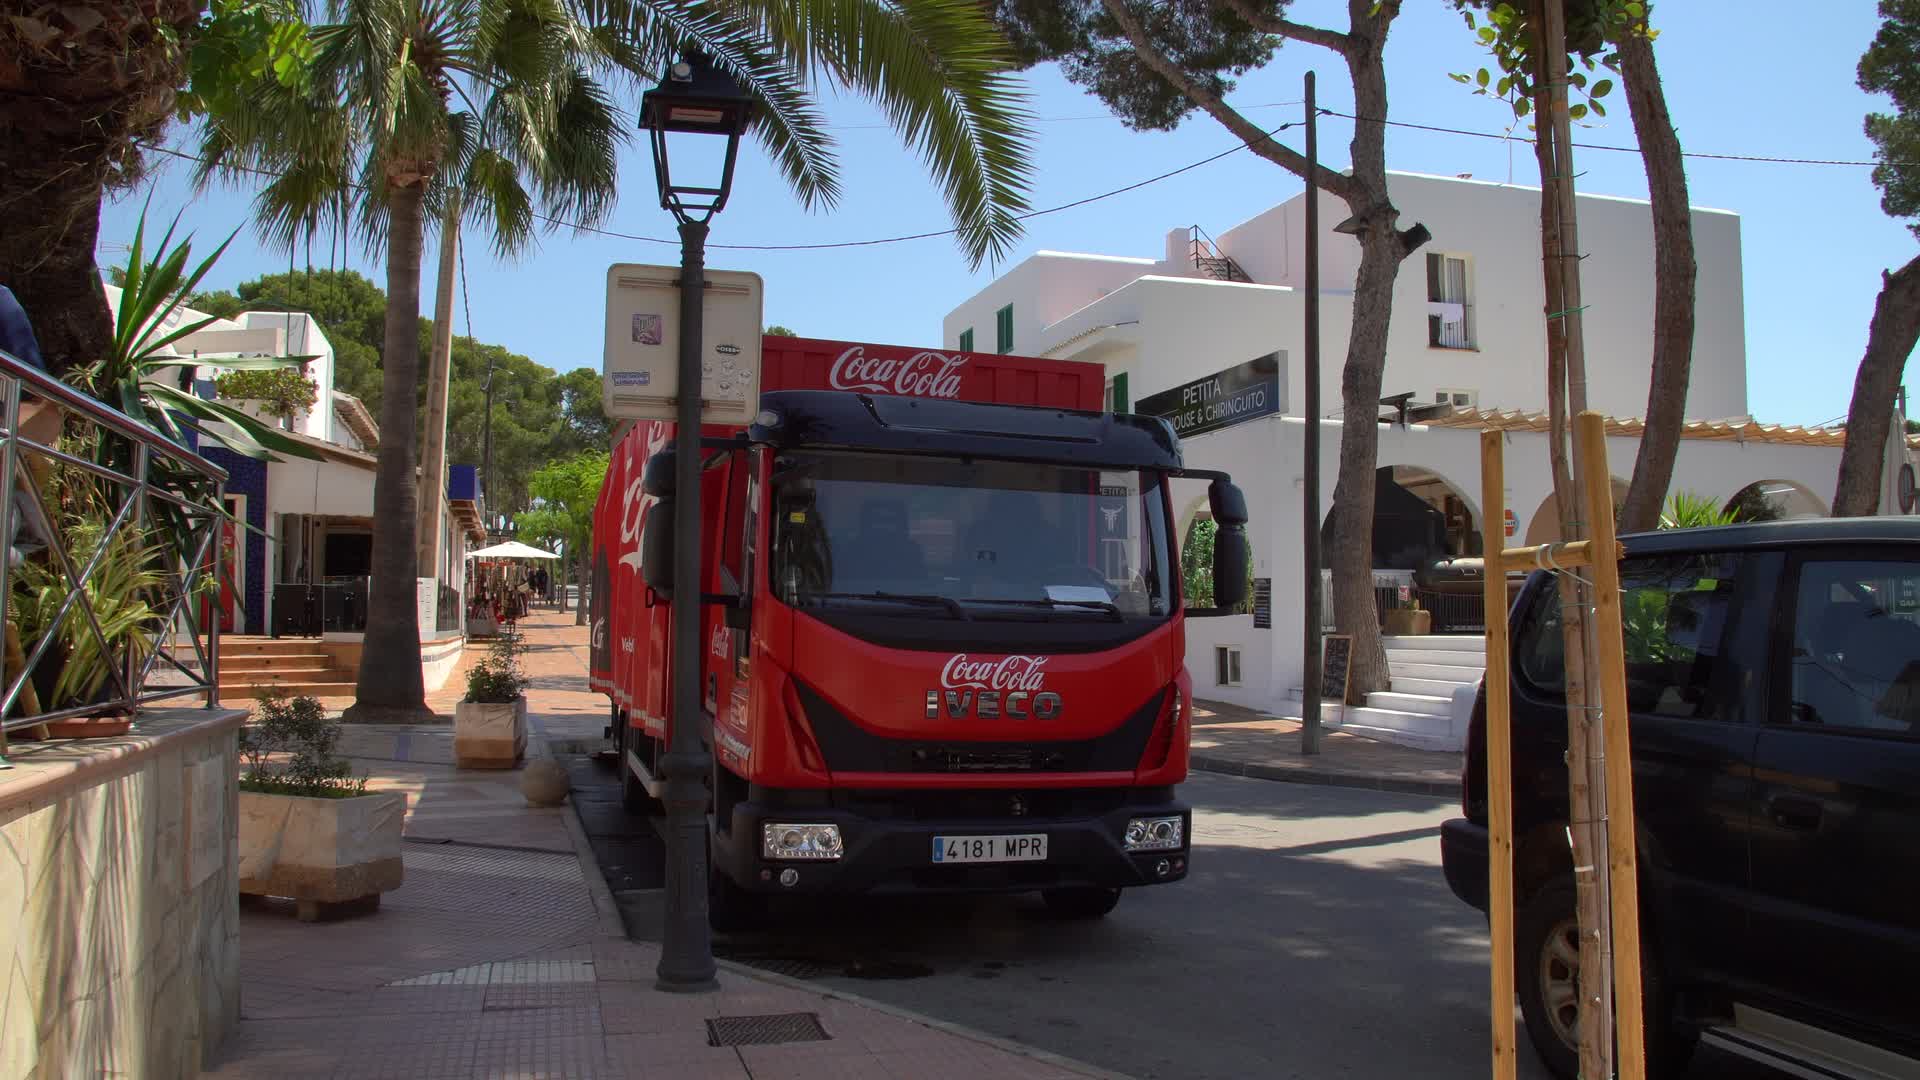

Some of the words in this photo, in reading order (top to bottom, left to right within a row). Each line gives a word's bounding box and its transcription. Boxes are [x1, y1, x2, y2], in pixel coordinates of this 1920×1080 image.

[829, 346, 970, 398] Coca-Cola
[1183, 378, 1221, 407] PETITA
[1197, 408, 1204, 425] &
[1205, 390, 1265, 421] CHIRINGUITO
[940, 653, 1049, 691] Coca-Cola
[925, 690, 1065, 721] IVECO
[946, 840, 994, 860] 4181
[1005, 838, 1042, 858] MPR
